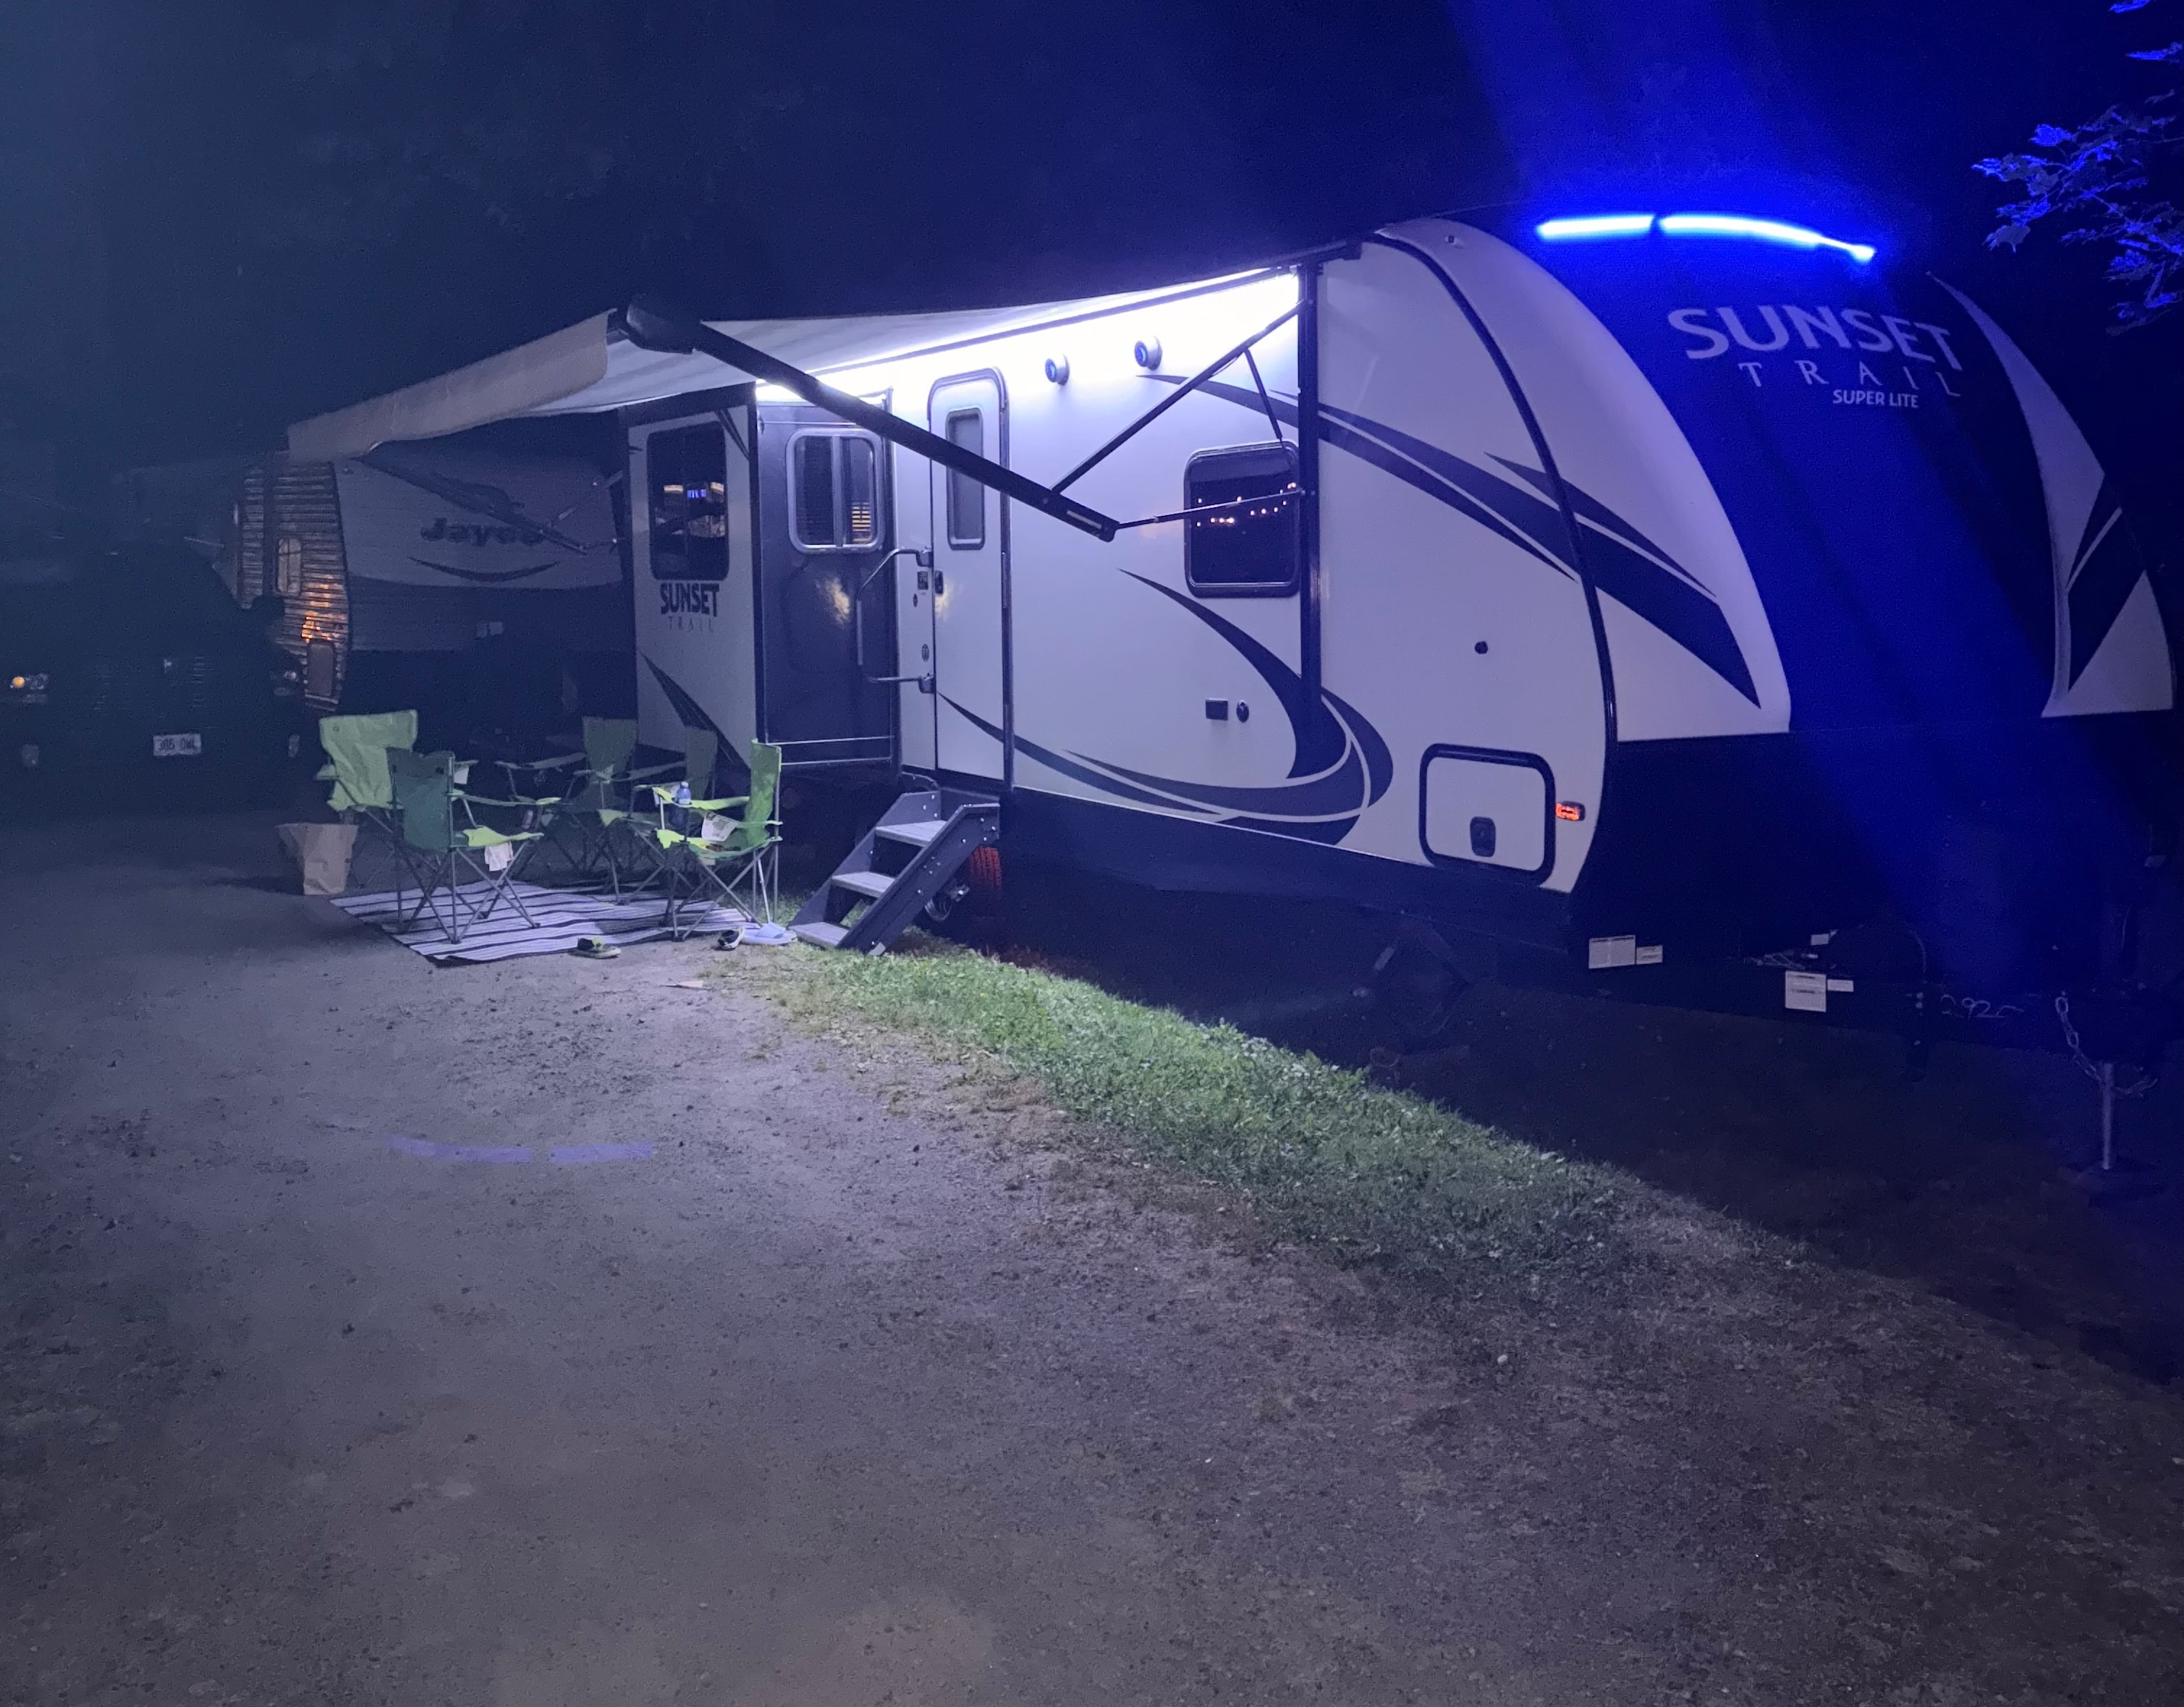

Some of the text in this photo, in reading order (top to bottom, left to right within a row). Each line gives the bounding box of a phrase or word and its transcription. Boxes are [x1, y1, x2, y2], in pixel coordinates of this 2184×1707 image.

[1667, 304, 1963, 371] SUNSET
[1738, 360, 1962, 397] TRAIL
[1832, 389, 1919, 409] SUPER LITE
[660, 583, 719, 617] SUNSET
[668, 616, 714, 633] TRAIL
